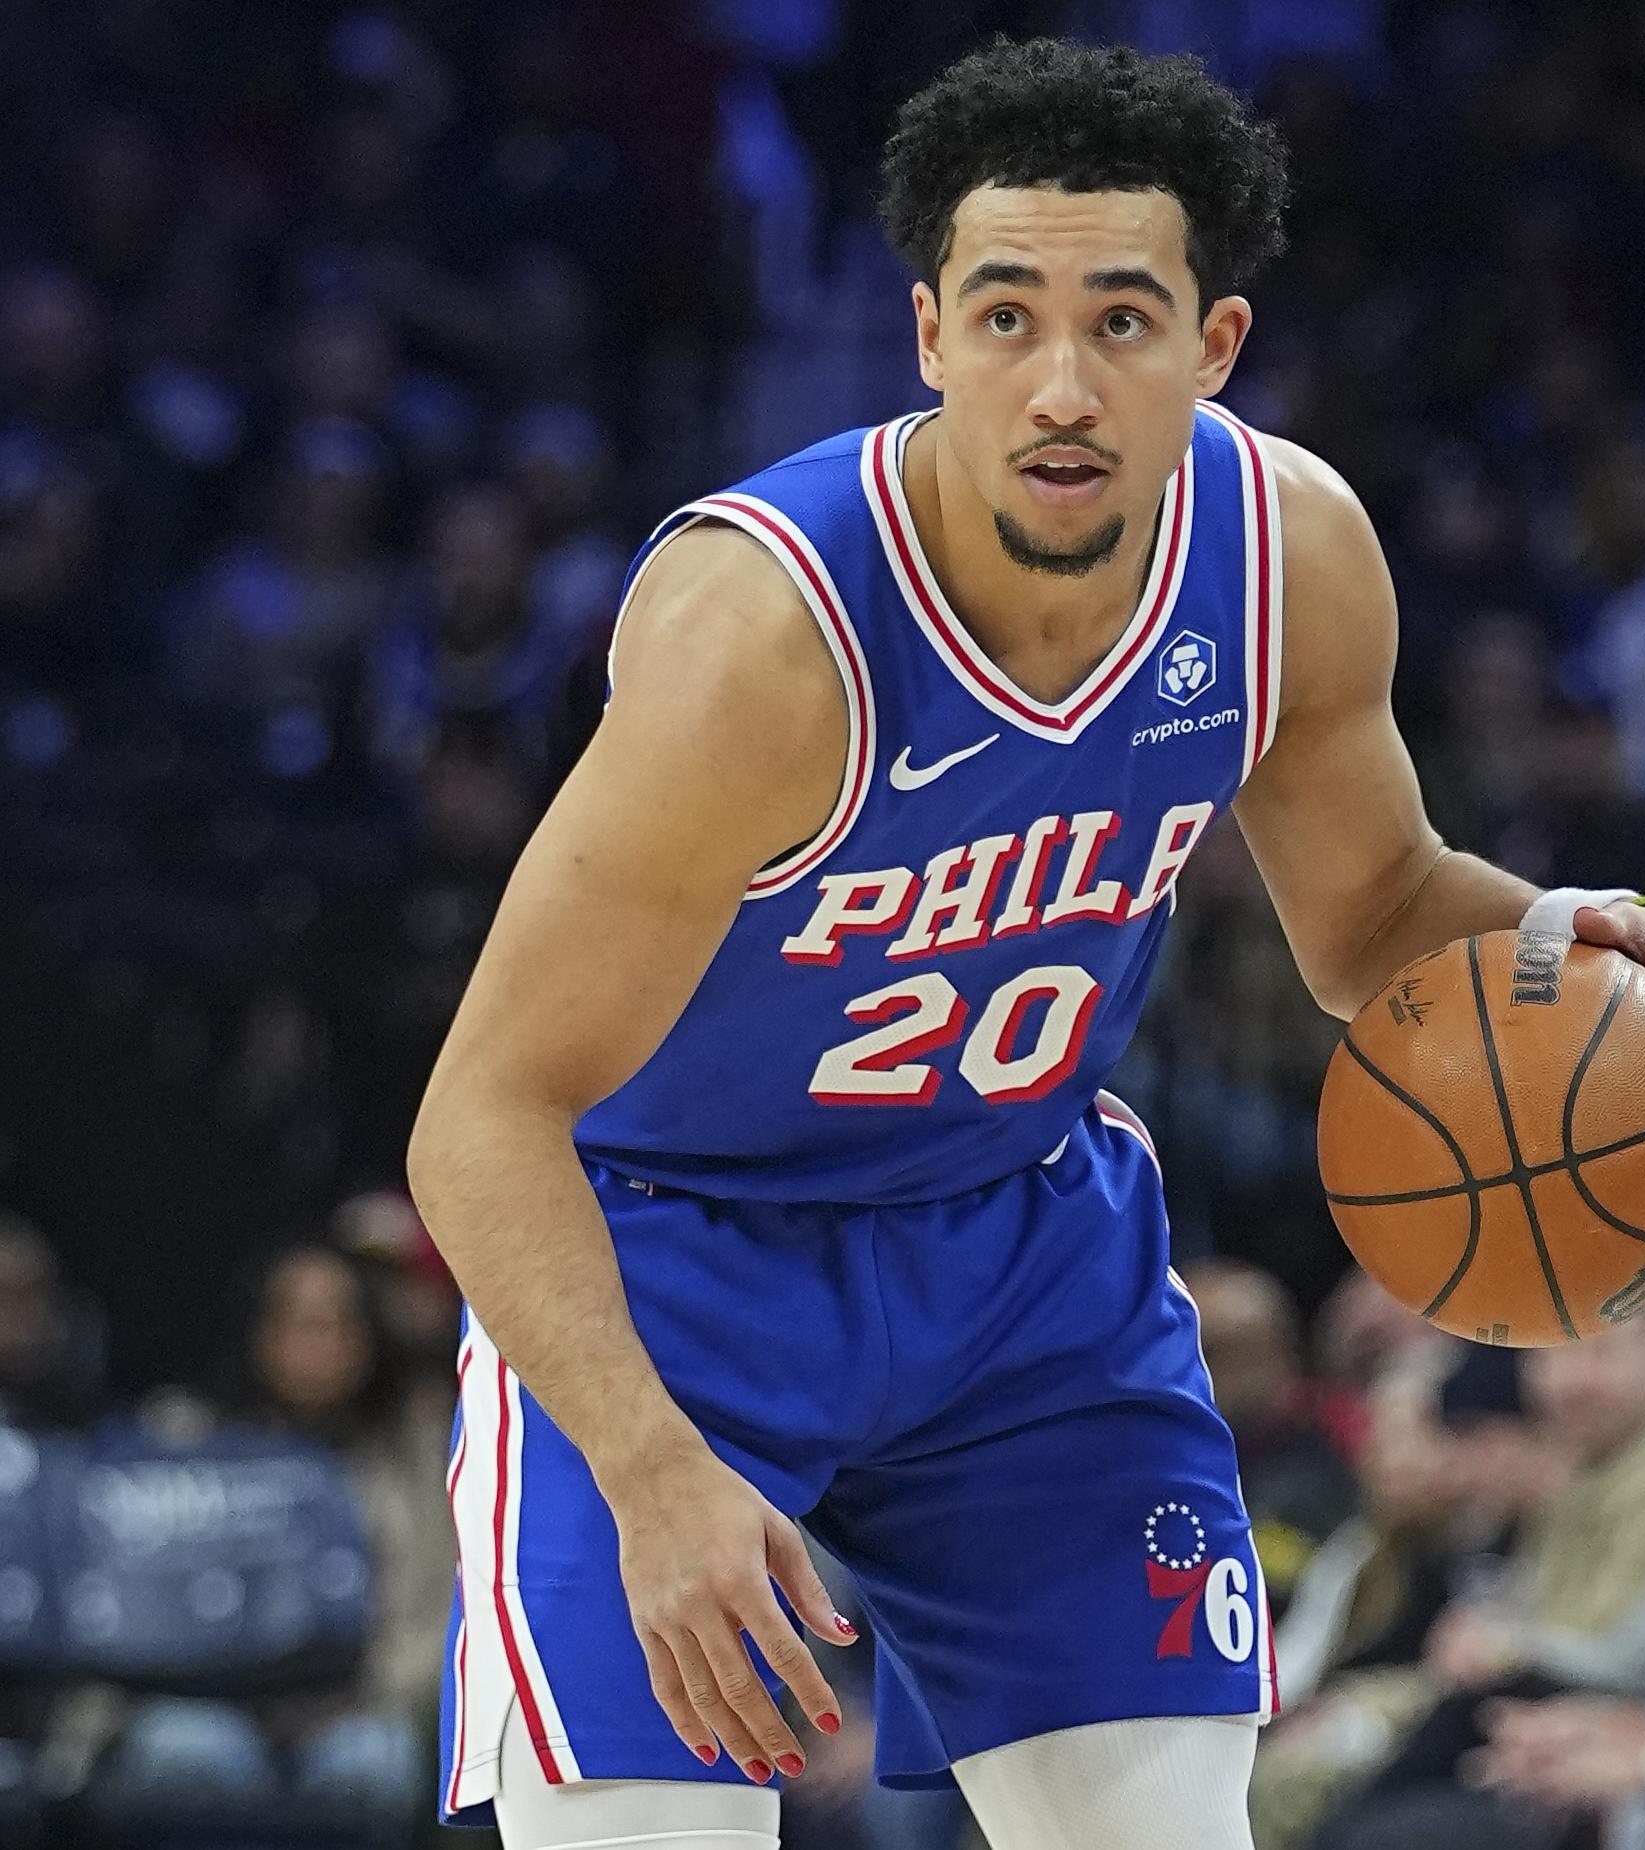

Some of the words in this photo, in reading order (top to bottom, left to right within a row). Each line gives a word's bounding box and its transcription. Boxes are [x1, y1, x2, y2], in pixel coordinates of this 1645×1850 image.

[1131, 707, 1240, 747] crypto.com
[808, 965, 1103, 1106] 20
[1145, 1557, 1254, 1663] 76
